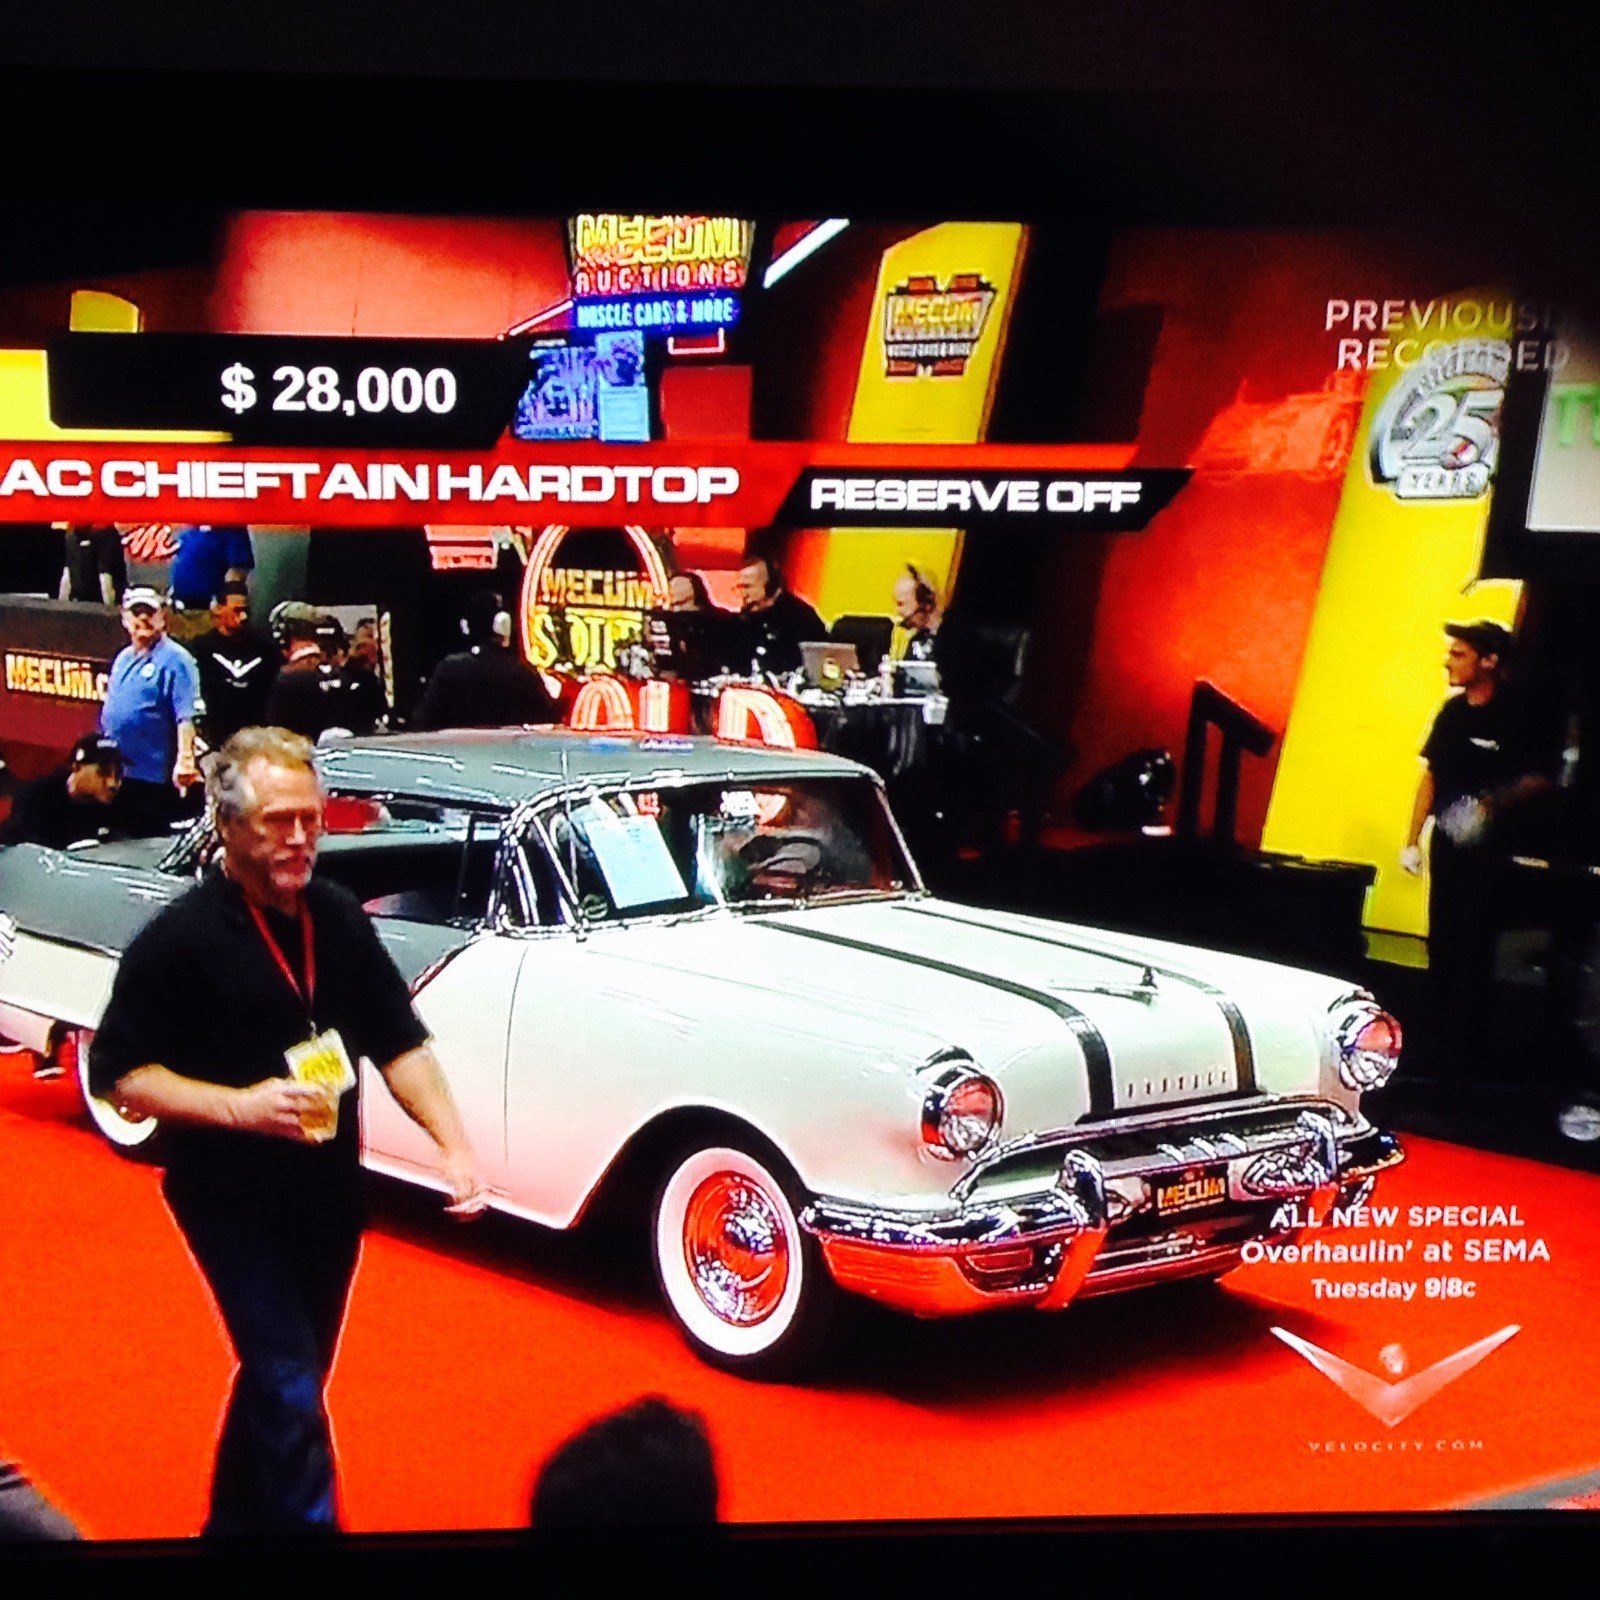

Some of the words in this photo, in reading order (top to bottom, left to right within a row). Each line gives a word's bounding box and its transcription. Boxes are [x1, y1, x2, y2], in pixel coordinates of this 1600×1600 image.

[575, 259, 739, 294] AUCTIONS
[577, 302, 632, 328] MUSCLE
[691, 296, 735, 323] MORE
[220, 362, 257, 414] $
[272, 365, 456, 416] 28,000
[100, 459, 429, 501] CHIEFTAIN
[437, 463, 740, 503] HARDTOP
[810, 478, 1040, 512] RESERVE
[1046, 480, 1143, 513] OFF
[541, 567, 652, 610] MECUM
[1156, 1176, 1226, 1209] MECUM
[1270, 1206, 1323, 1228] ALL
[1332, 1206, 1400, 1228] NEW
[1408, 1205, 1526, 1227] SPECIAL
[1423, 1242, 1454, 1262] at
[1464, 1238, 1551, 1262] SEMA
[1311, 1278, 1417, 1301] Tuesday
